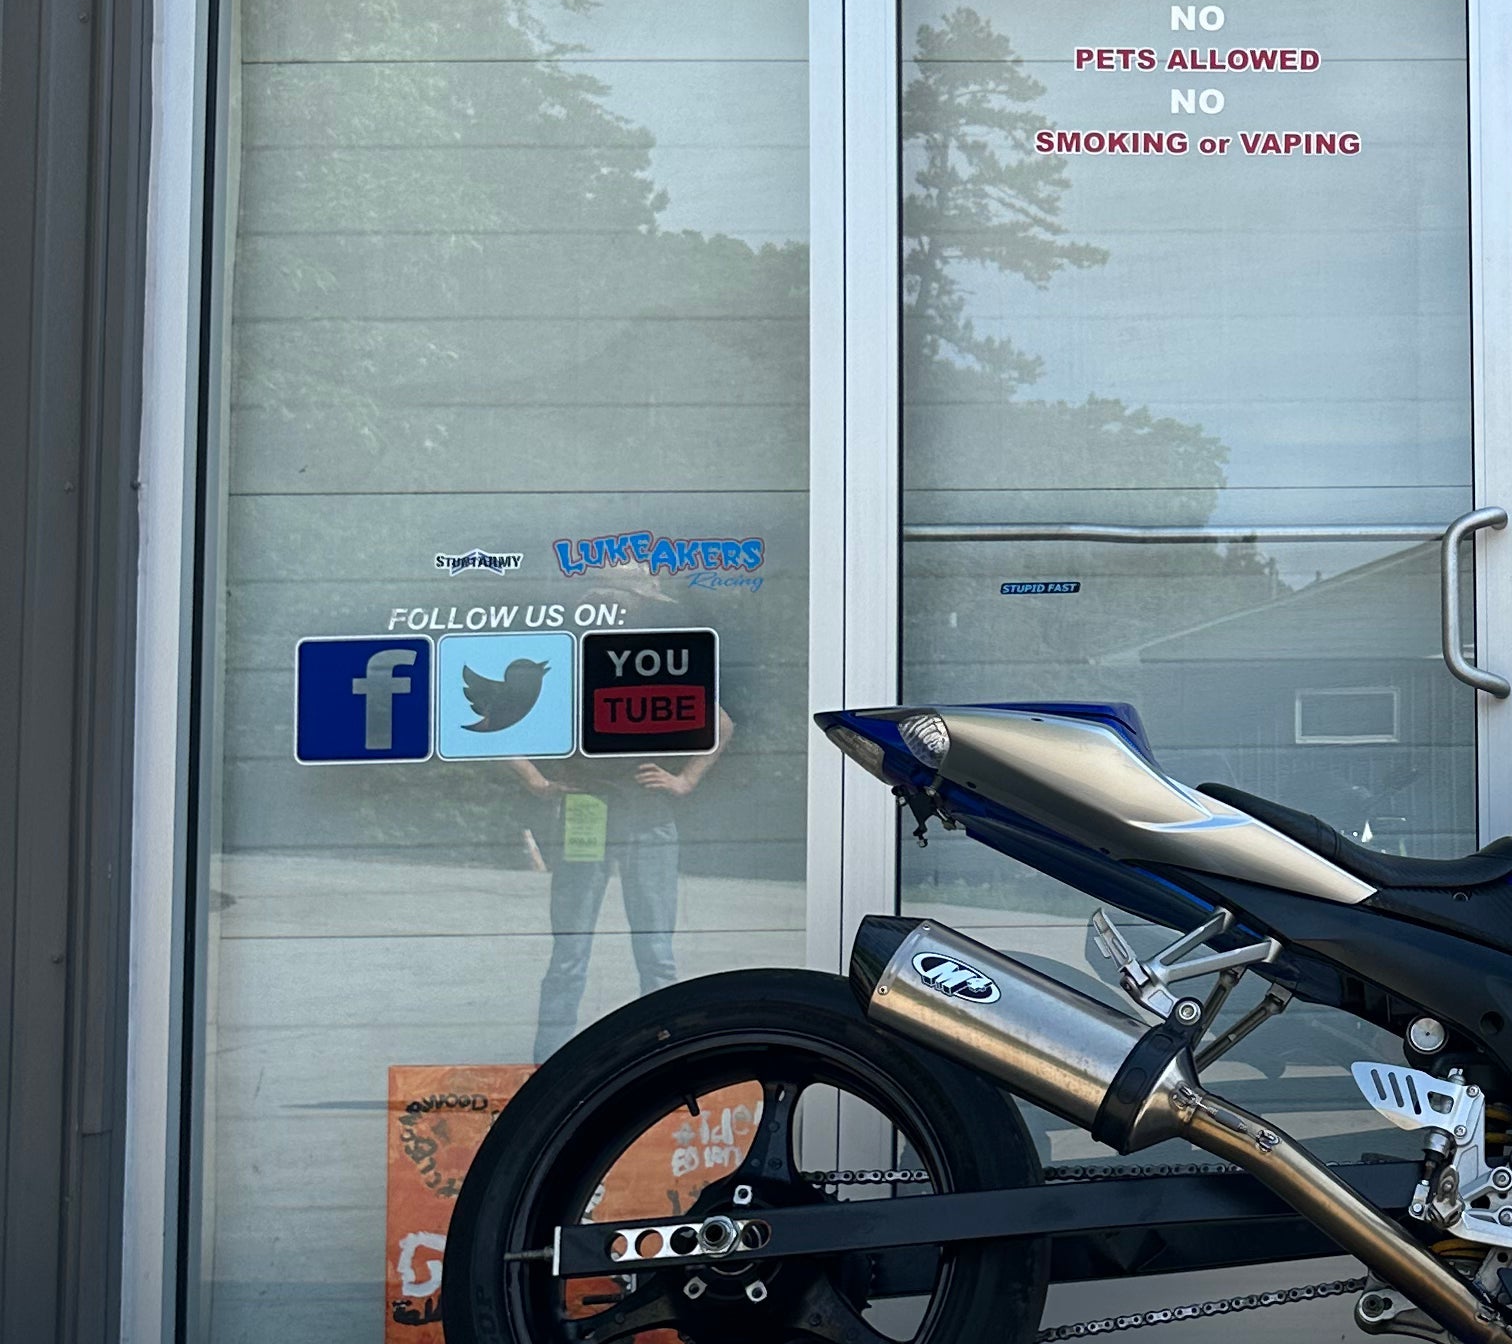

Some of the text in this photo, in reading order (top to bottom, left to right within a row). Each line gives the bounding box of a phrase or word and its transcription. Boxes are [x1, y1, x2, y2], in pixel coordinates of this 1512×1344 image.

[1170, 5, 1225, 31] NO
[1075, 48, 1321, 72] PETS ALLOWED
[1170, 88, 1225, 114] NO
[1035, 131, 1361, 156] SMOKING or VAPING
[686, 572, 765, 593] Racing
[1002, 583, 1078, 594] STUPID FAST
[388, 602, 628, 631] FOLLOW US ON:
[606, 649, 690, 678] YOU
[351, 649, 417, 750] f
[602, 694, 696, 724] TUBE
